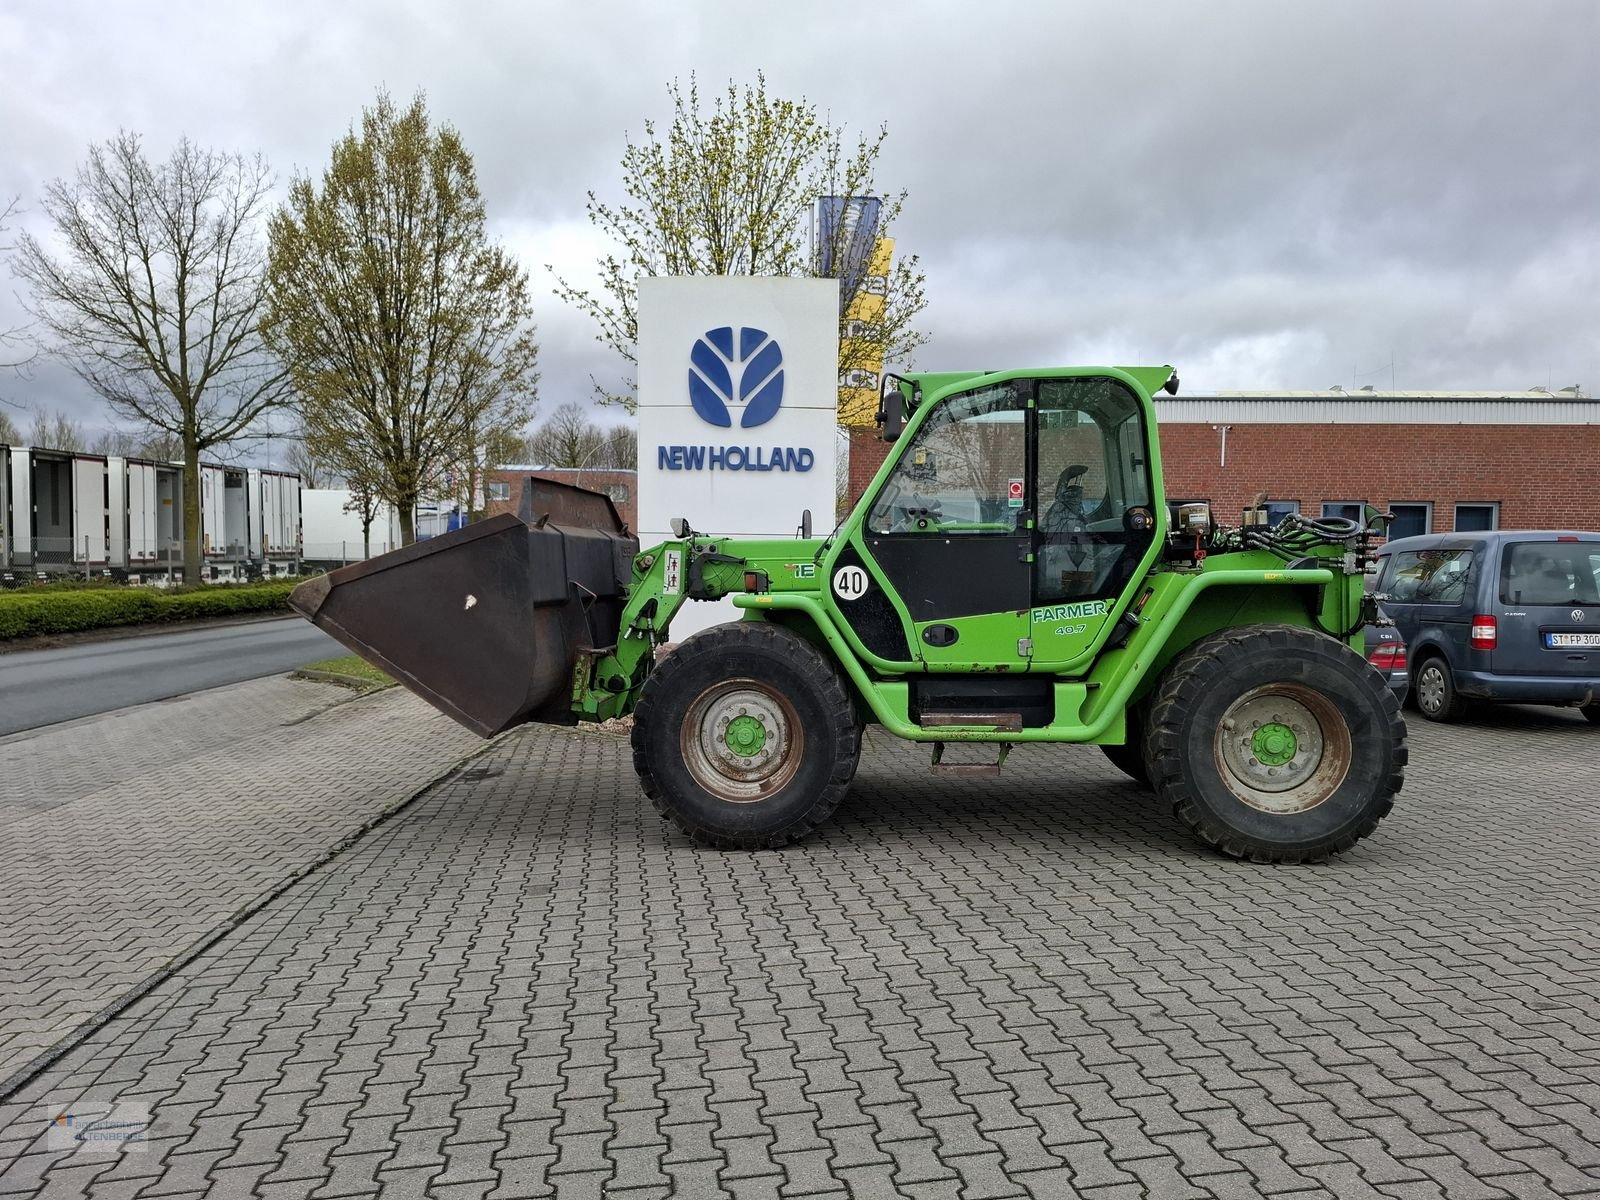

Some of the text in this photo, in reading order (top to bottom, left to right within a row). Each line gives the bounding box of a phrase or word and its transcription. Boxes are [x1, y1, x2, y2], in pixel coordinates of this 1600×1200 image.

[658, 445, 815, 472] NEW HOLLAND
[838, 572, 862, 595] 40
[1032, 601, 1108, 623] FARMER
[1055, 624, 1086, 635] 40.7
[1553, 635, 1563, 645] ST
[1570, 635, 1581, 645] FP
